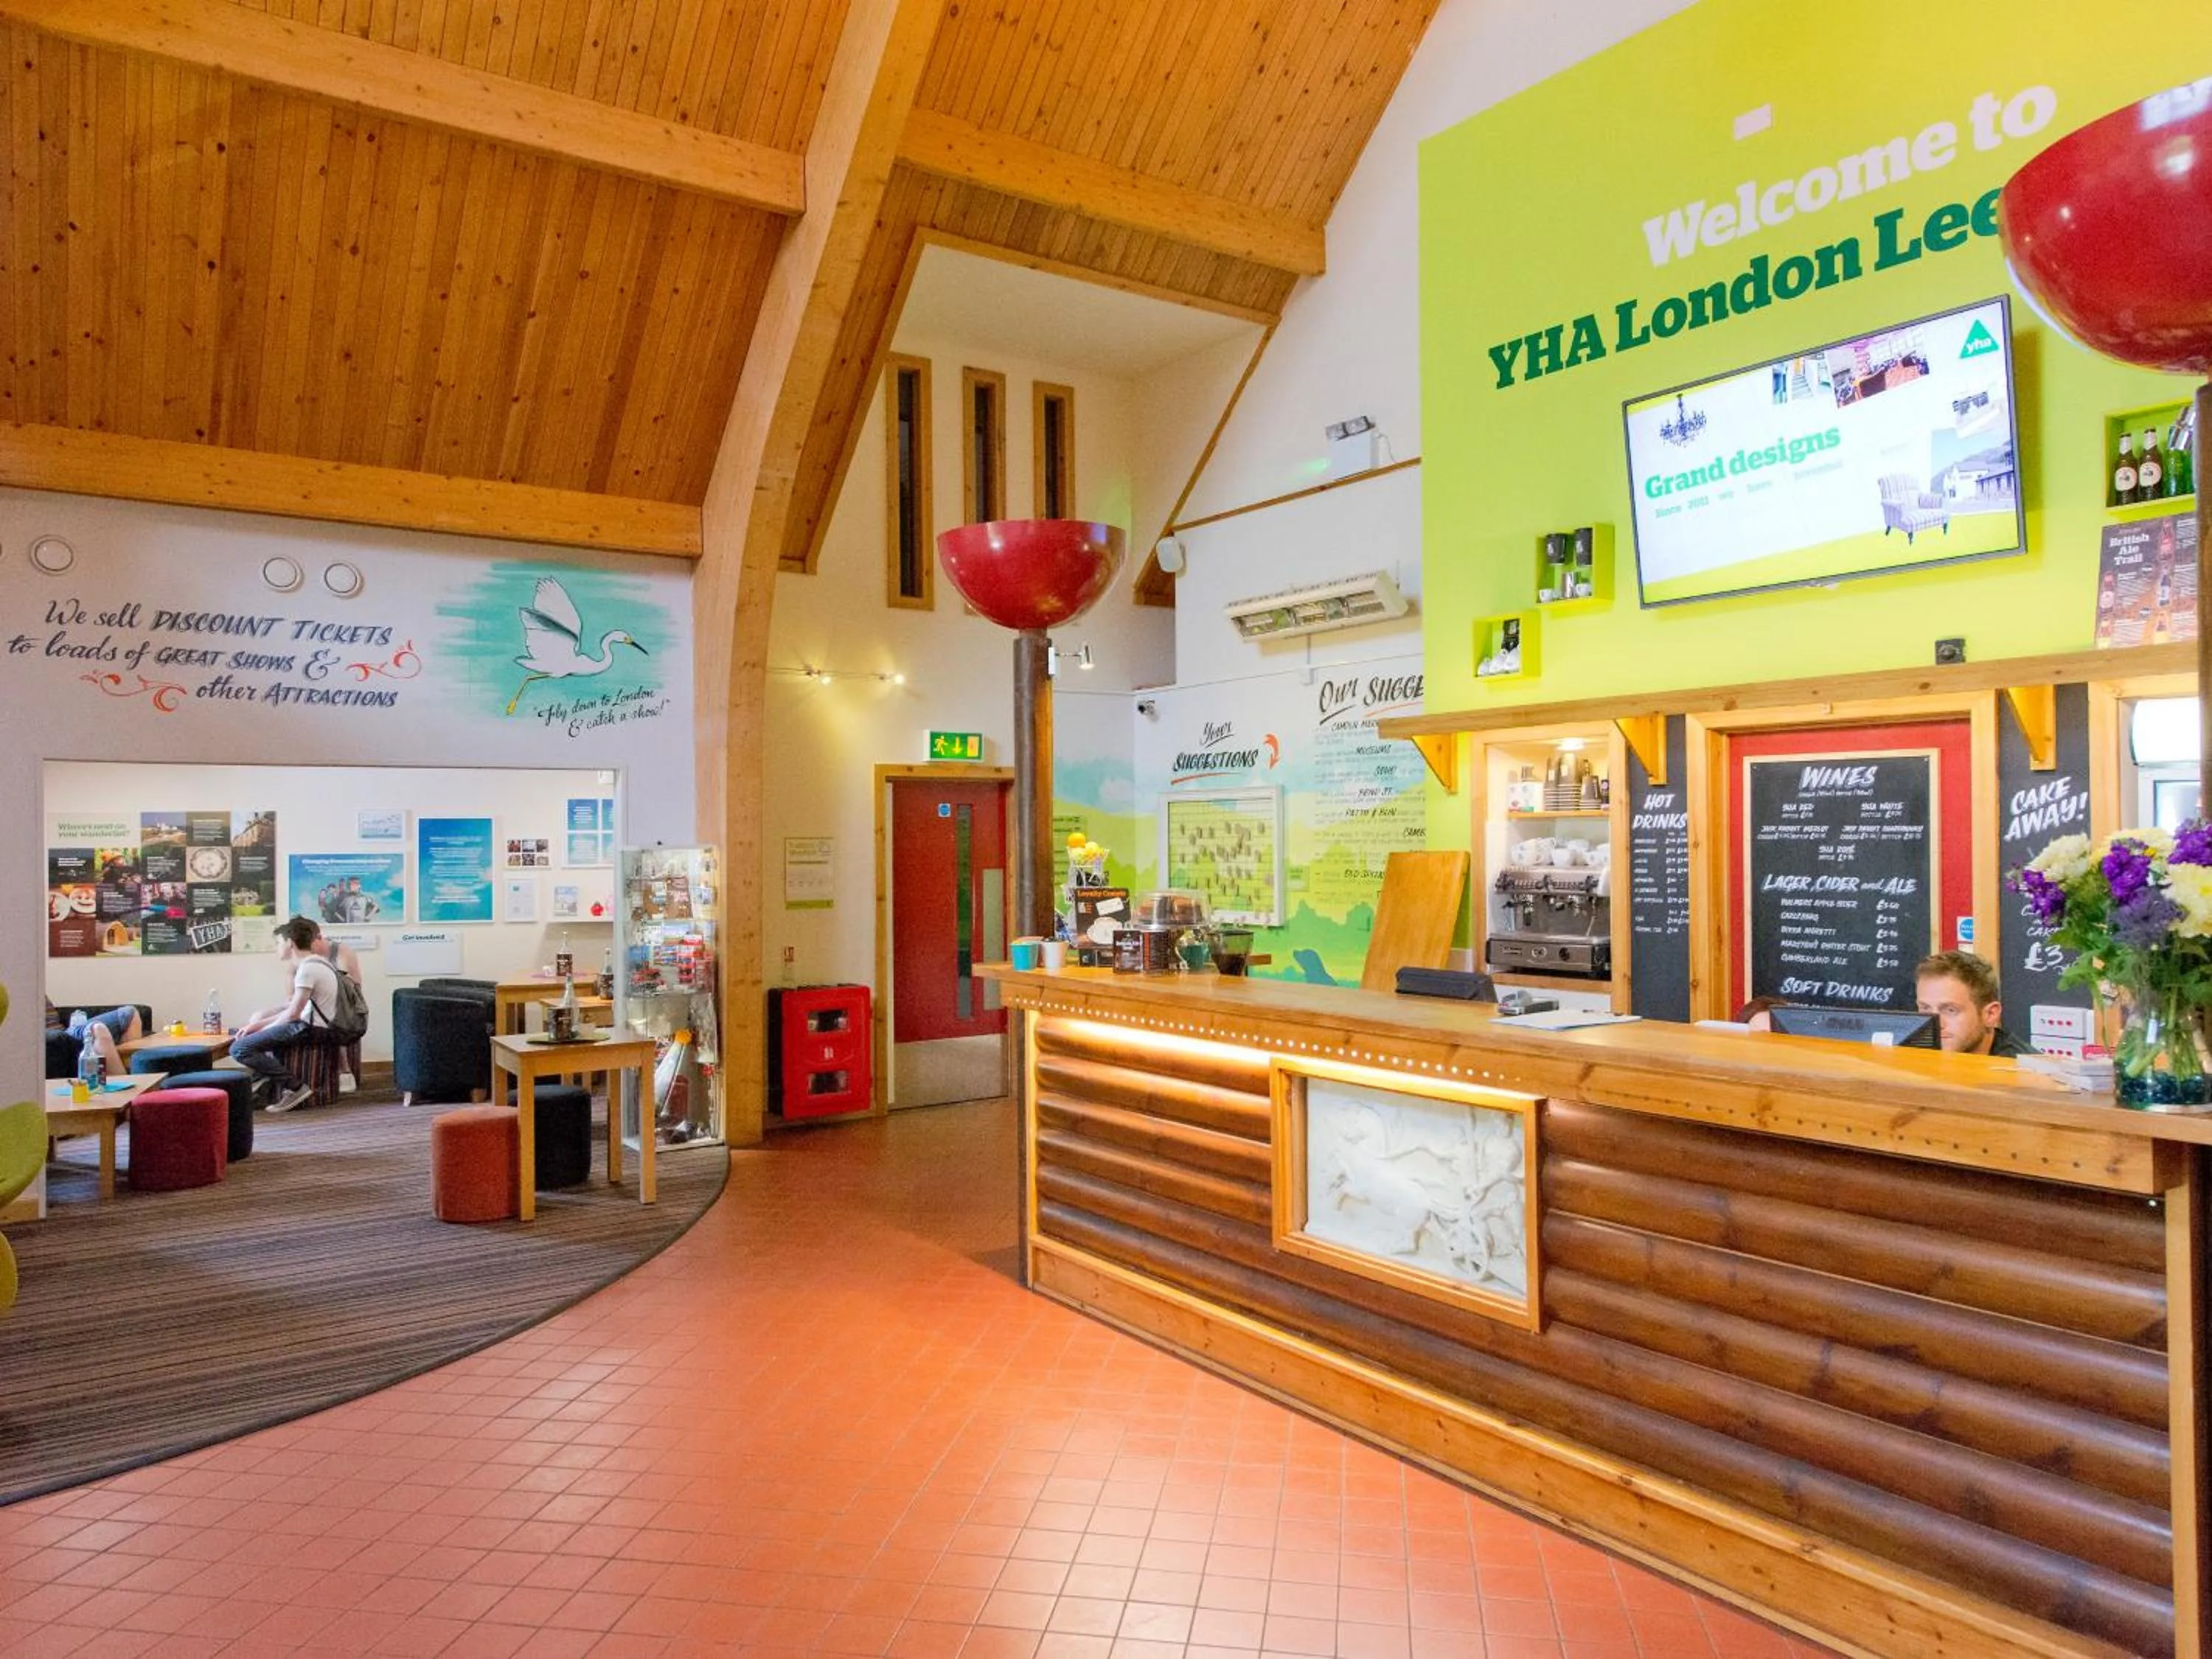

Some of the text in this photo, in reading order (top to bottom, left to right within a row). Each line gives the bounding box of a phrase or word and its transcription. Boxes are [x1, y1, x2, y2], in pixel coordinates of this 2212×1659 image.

[1642, 85, 2057, 267] Welcome to
[1488, 313, 1606, 389] YHA
[1615, 236, 1862, 352] London
[1966, 337, 1992, 355] yha
[1644, 426, 1842, 500] Grand designs
[2110, 533, 2149, 548] British
[2118, 545, 2140, 555] Ale
[2113, 552, 2143, 566] Trail
[44, 598, 394, 647] We sell DISCOUNT TICKETS
[7, 630, 341, 681] to loads of GREAT SHOWS &
[195, 674, 399, 709] other ATTRACTIONS
[571, 698, 597, 715] down
[601, 693, 619, 707] to
[611, 685, 655, 706] London
[1319, 677, 1359, 713] Our
[585, 708, 616, 729] catch
[1200, 720, 1232, 746] Your
[1172, 748, 1259, 772] SUGGESTIONS
[1798, 765, 1879, 790] WINES
[1643, 793, 1676, 810] HOT
[2010, 776, 2071, 815] CAKE
[1632, 812, 1688, 830] DRINKS
[2003, 791, 2089, 843] AWAY!
[1815, 874, 1860, 893] CIDER
[1860, 878, 1885, 890] and
[1884, 877, 1919, 894] ALE
[1781, 976, 1894, 1003] SOFT DRINKS
